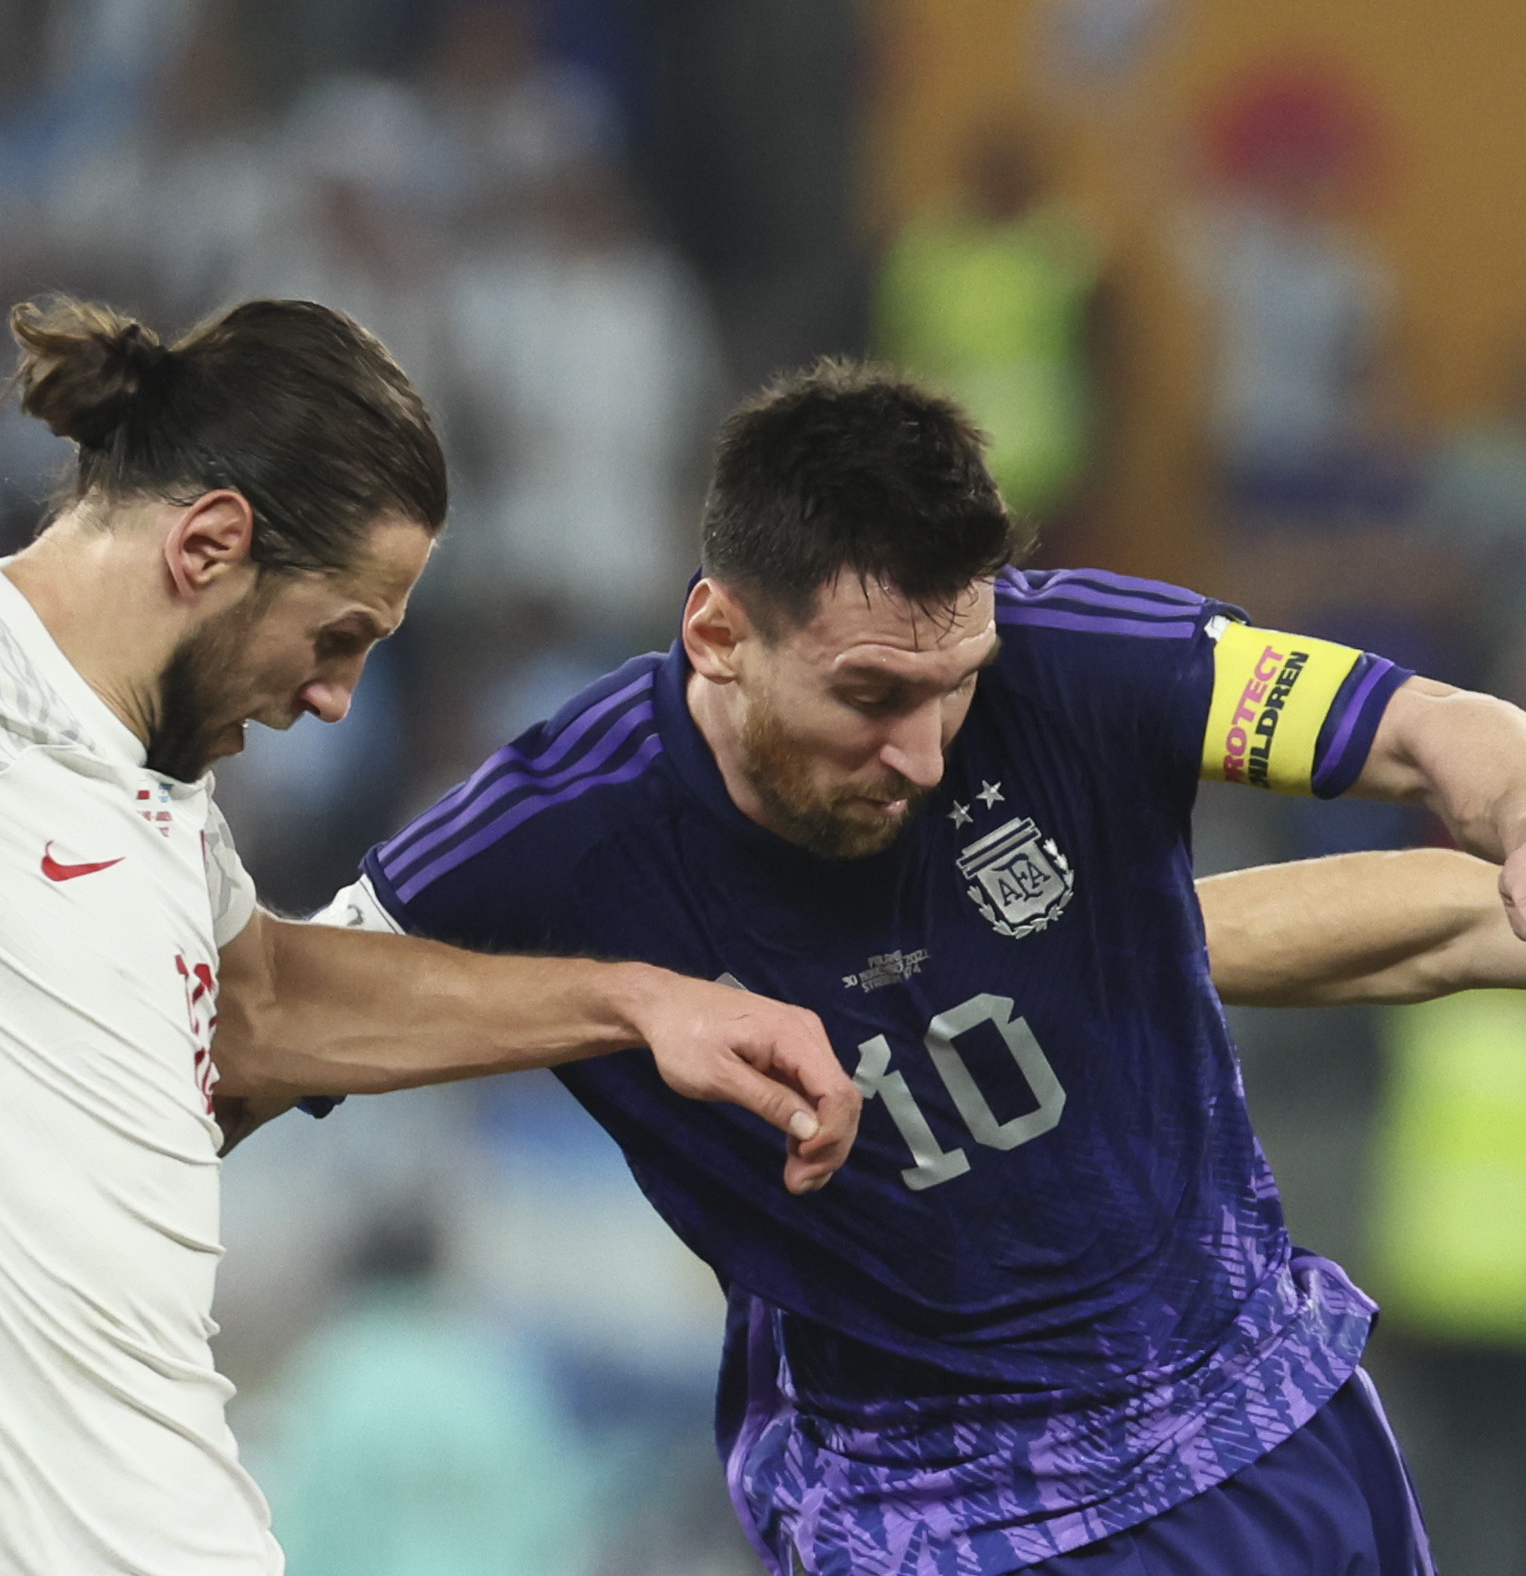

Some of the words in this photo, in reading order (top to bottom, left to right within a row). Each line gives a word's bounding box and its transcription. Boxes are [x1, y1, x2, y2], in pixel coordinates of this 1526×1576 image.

[1247, 651, 1310, 789] HILDREN
[991, 853, 1051, 907] AFA
[852, 992, 1068, 1191] 10
